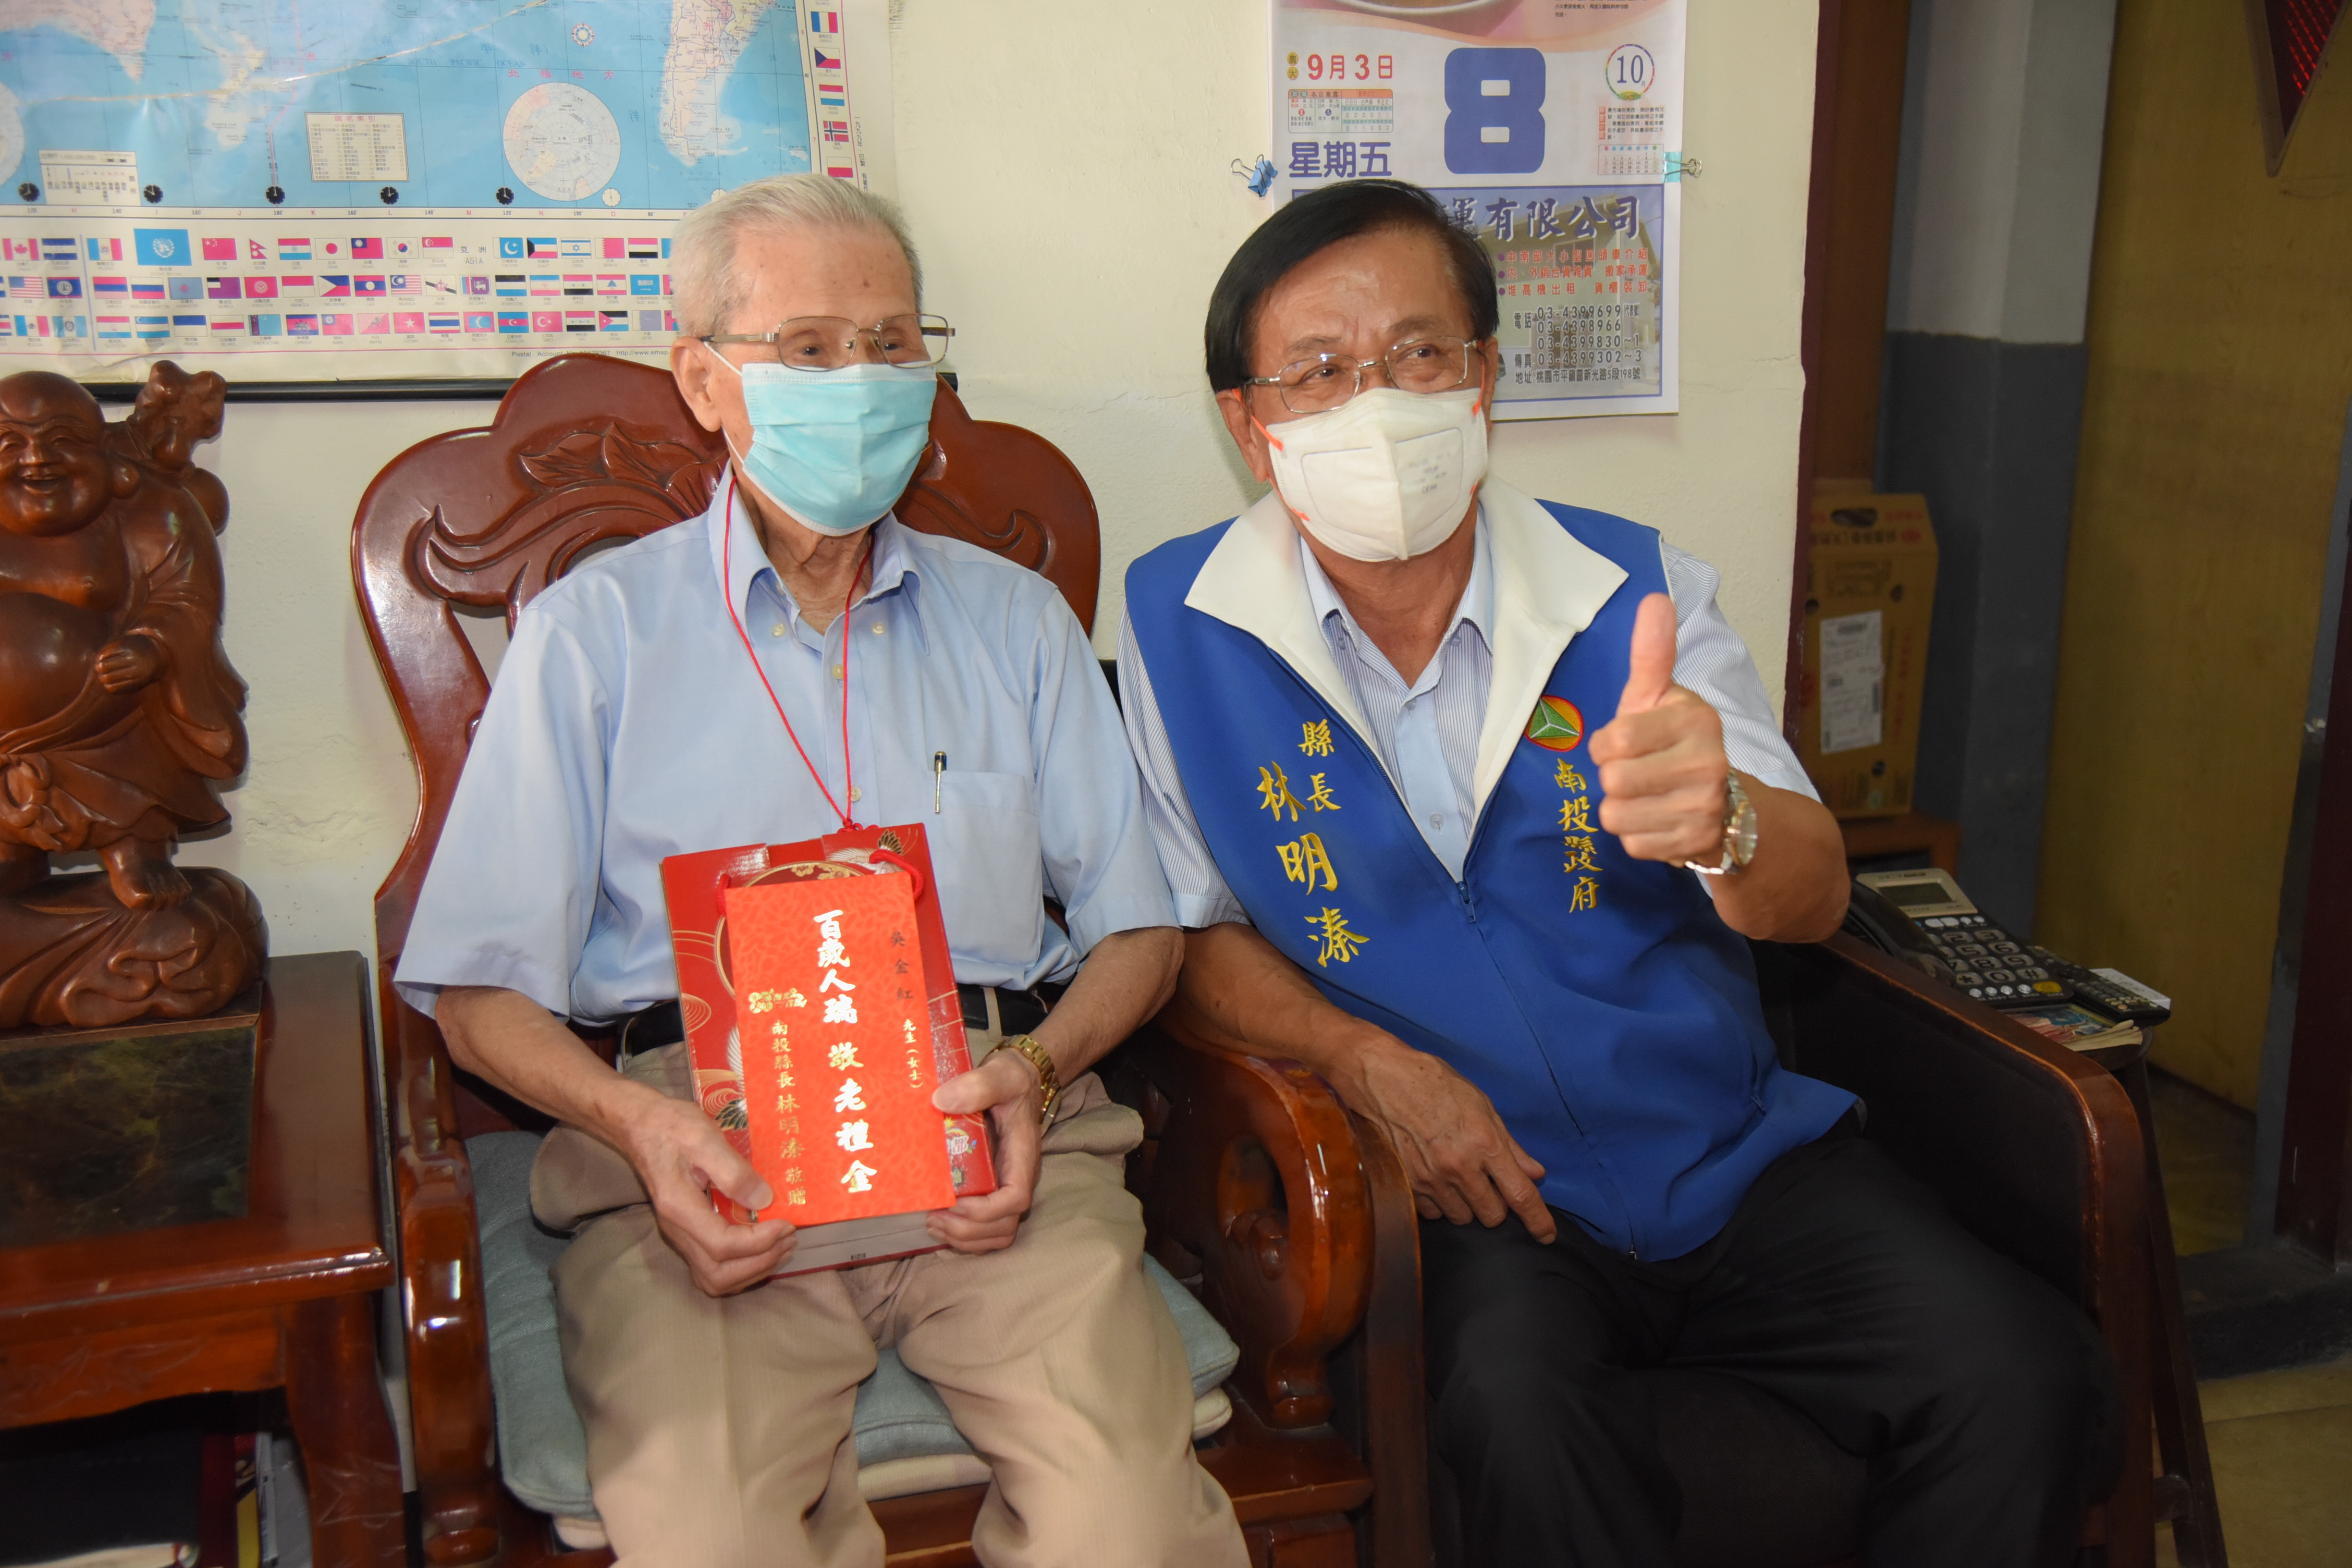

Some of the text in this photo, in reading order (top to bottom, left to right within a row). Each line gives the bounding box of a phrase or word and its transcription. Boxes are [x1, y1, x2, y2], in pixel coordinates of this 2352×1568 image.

[1307, 54, 1392, 80] 9月3日
[1616, 55, 1644, 83] 10
[1444, 47, 1546, 174] 8
[1289, 141, 1392, 178] 星期五
[1506, 248, 1648, 263] 中南部大小型回頭車介紹
[1604, 264, 1648, 278] 搬家承運
[1508, 280, 1648, 297] 堆高機出租 貨櫃裝卸
[1537, 304, 1621, 320] 03-4399699
[1537, 320, 1621, 334] 03-4398966
[1536, 367, 1640, 383] 桃園市平鎮區新光路5段198號
[1298, 718, 1341, 813] 縣長
[1256, 760, 1370, 968] 林明溱
[1960, 944, 2013, 955] 5 6
[1975, 959, 1995, 969] 8
[1990, 972, 2009, 981] 0
[814, 909, 877, 1193] 百歲人瑞 敬老禮金
